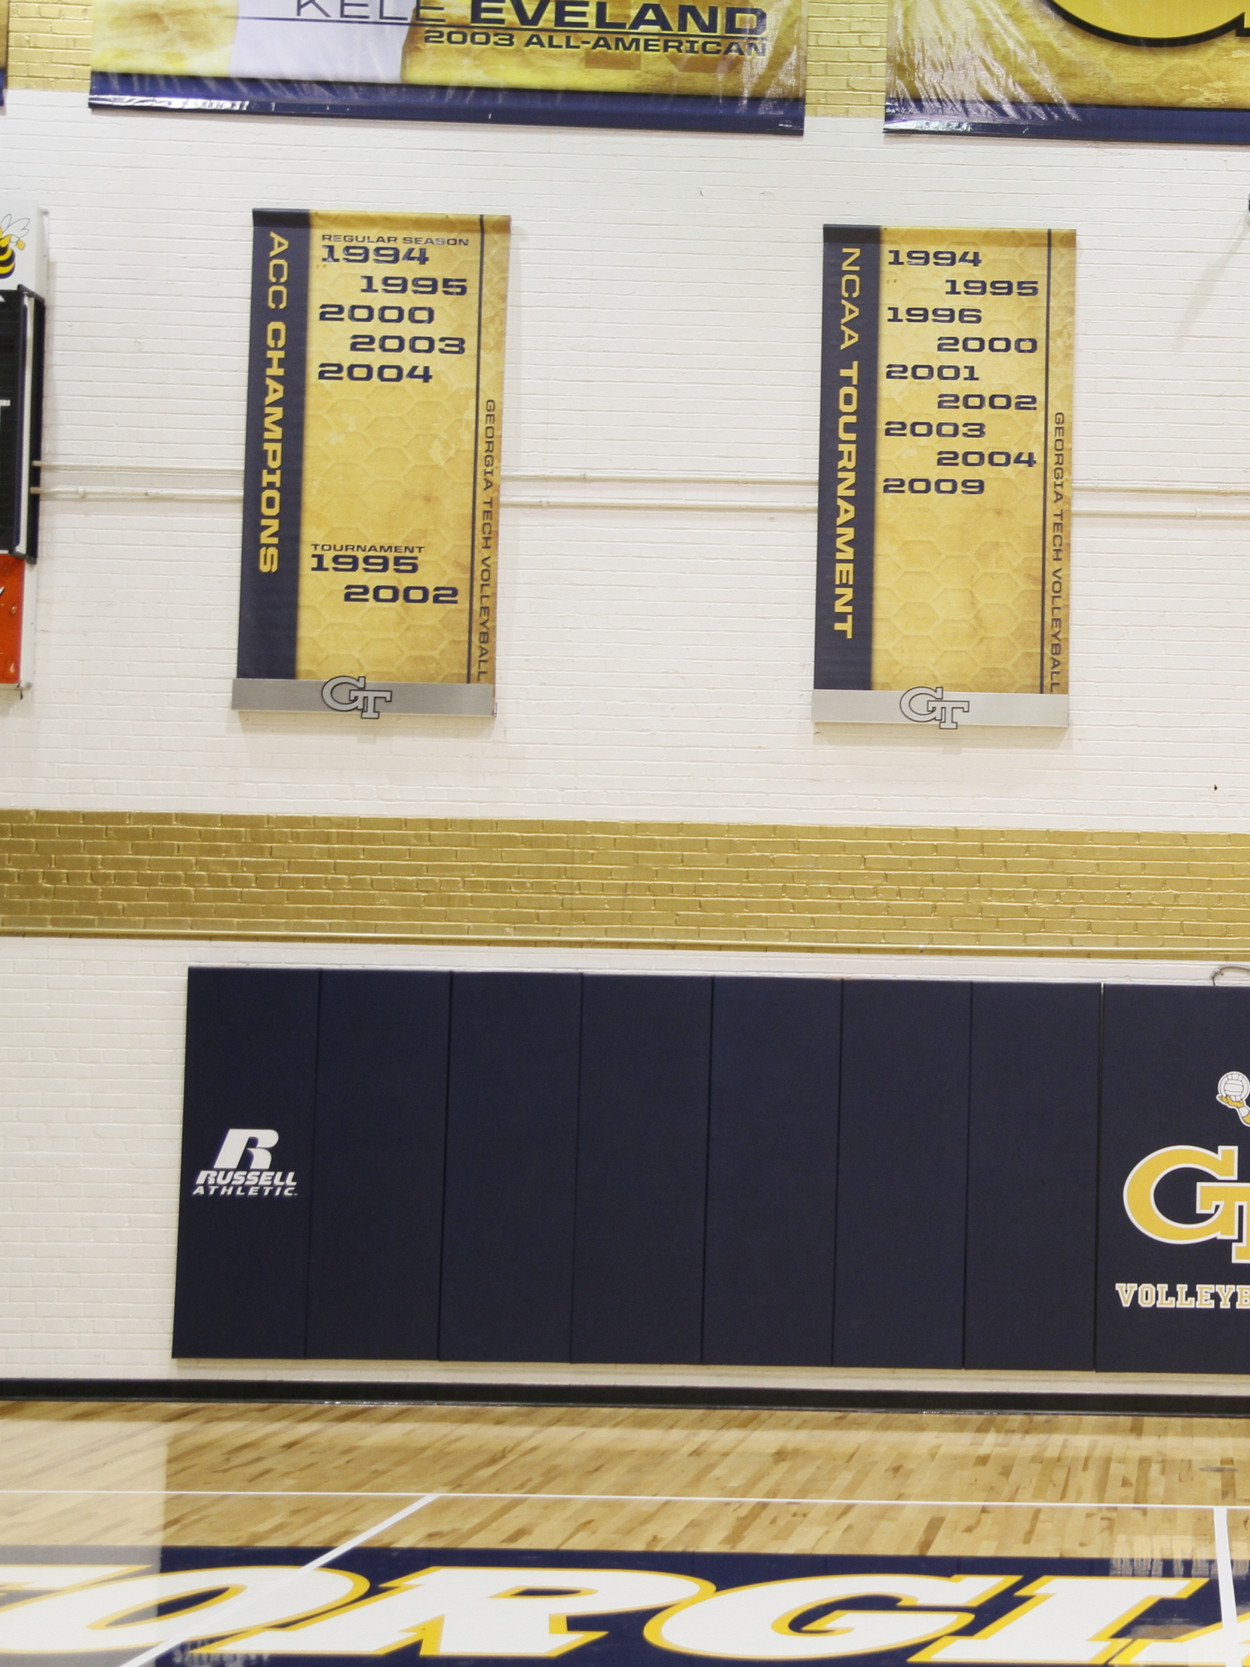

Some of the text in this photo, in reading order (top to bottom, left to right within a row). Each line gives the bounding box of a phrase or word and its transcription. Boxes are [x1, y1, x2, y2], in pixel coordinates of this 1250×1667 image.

[470, 0, 768, 34] EVELAND
[424, 29, 767, 56] 2003 ALL-AMERICAN
[321, 234, 469, 246] REGULAR SEASON
[321, 245, 430, 265] 1994
[888, 250, 982, 267] 1994
[360, 275, 468, 295] 1995
[945, 279, 1039, 296] 1995
[319, 303, 435, 324] 2000
[887, 307, 982, 324] 1996
[349, 334, 466, 354] 2003
[936, 336, 1038, 353] 2000
[317, 362, 433, 383] 2004
[885, 363, 980, 381] 2001
[259, 231, 289, 573] ACC CHAMPIONS
[937, 393, 1037, 411] 2002
[884, 421, 986, 438] 2003
[833, 248, 861, 639] NCAA TOURNAMENT
[936, 451, 1037, 468] 2004
[883, 477, 985, 495] 2009
[310, 543, 425, 554] TOURNAMENT
[477, 399, 496, 681] GEORGIA TECH VOLLEYBALL
[1050, 412, 1065, 693] GEORGIA TECH VOLLEYBALL
[310, 554, 419, 574] 1995
[343, 584, 459, 604] 2002
[321, 675, 393, 719] GT
[899, 686, 970, 729] GT
[195, 1170, 297, 1186] RUSSELL
[192, 1185, 295, 1196] ATHLETIC
